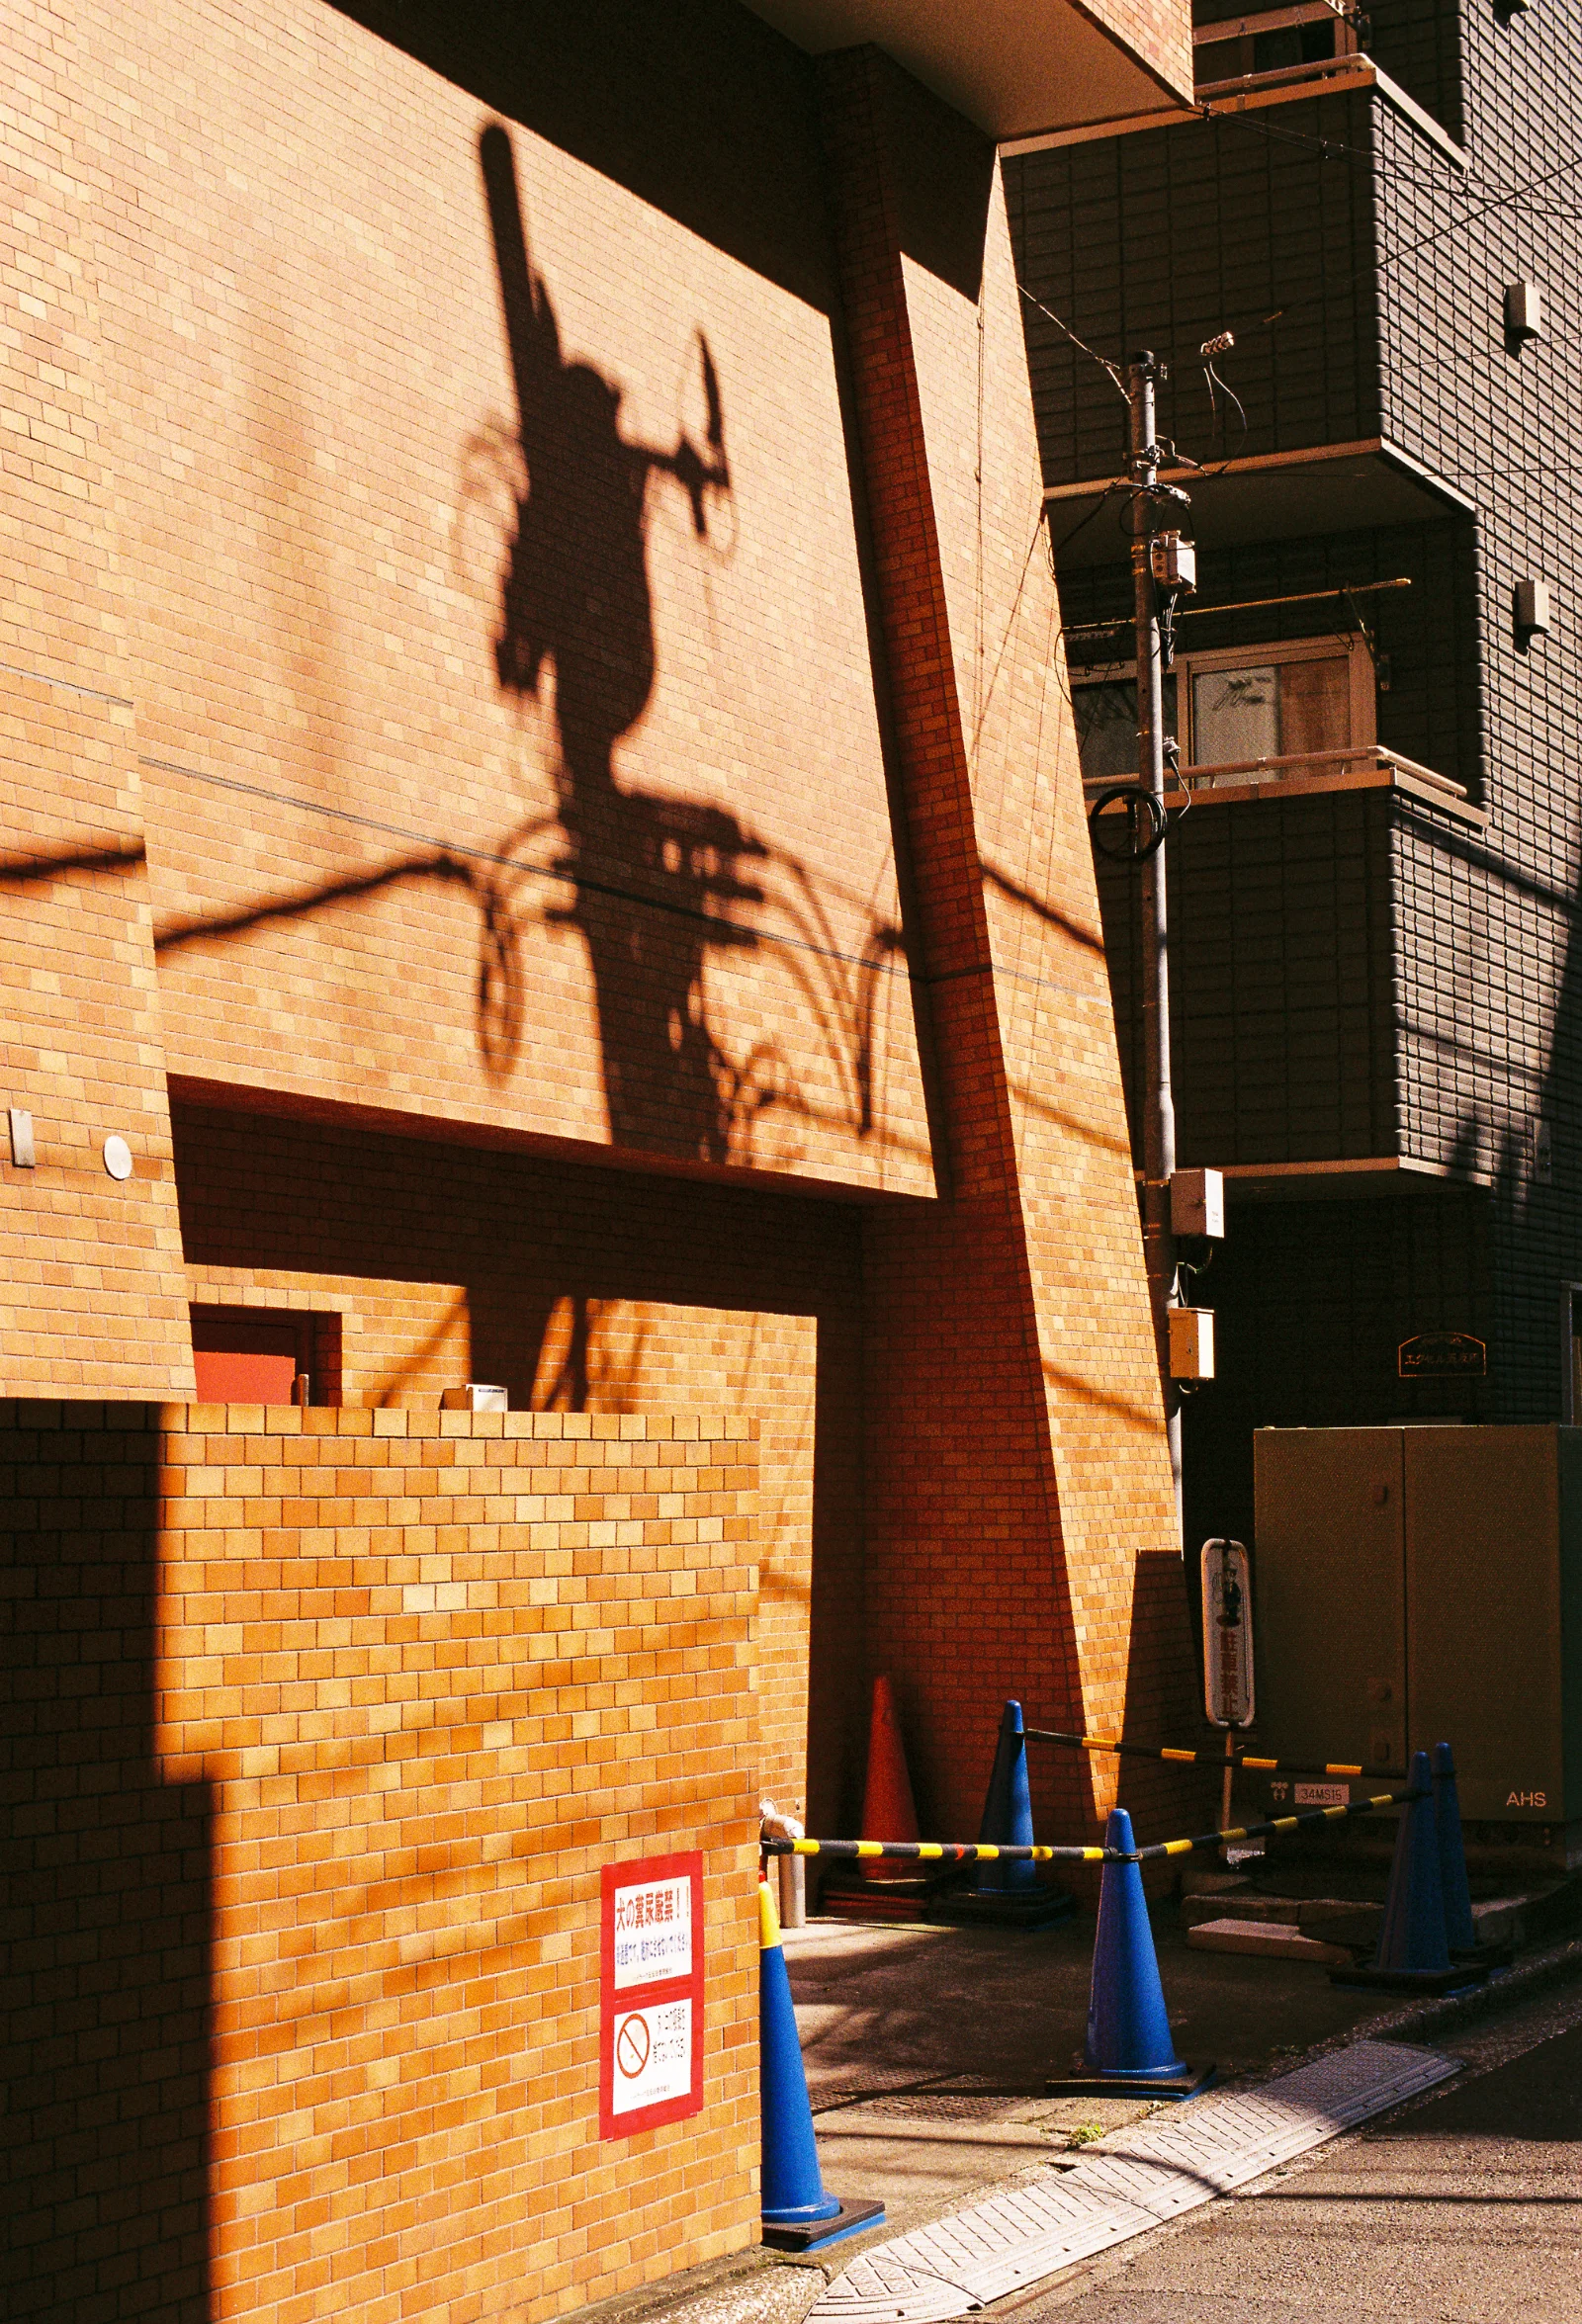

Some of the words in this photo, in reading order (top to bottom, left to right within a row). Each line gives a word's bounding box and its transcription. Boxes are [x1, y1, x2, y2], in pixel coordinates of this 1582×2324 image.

[1219, 1630, 1239, 1715] 駐車禁止
[1506, 1791, 1547, 1807] AHS
